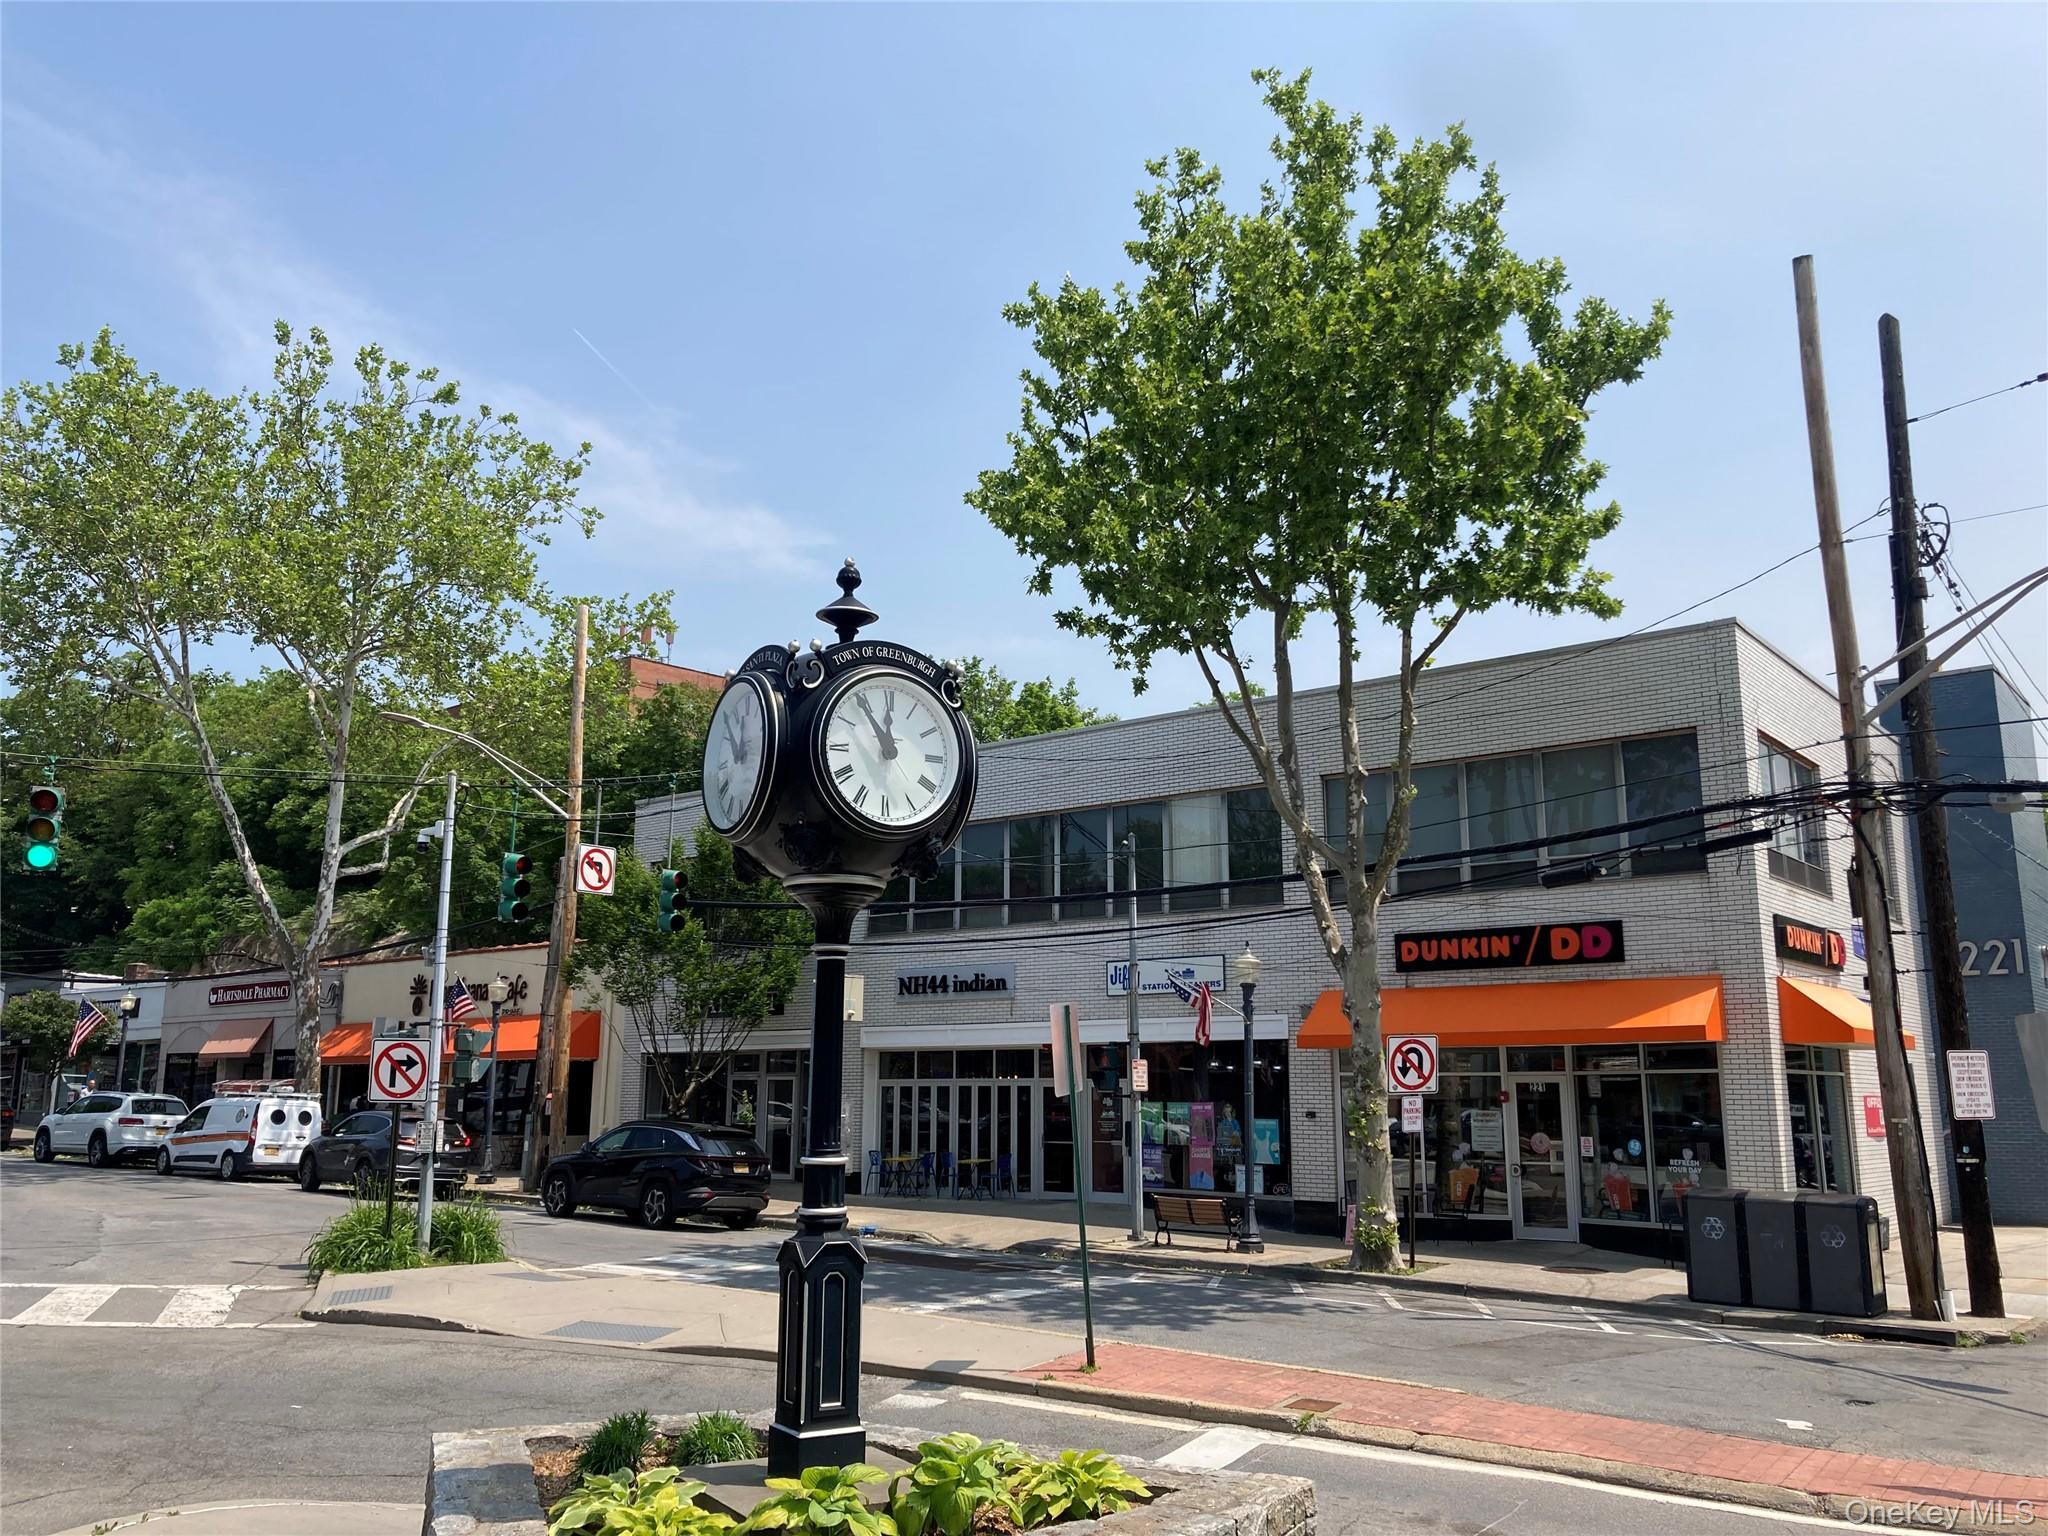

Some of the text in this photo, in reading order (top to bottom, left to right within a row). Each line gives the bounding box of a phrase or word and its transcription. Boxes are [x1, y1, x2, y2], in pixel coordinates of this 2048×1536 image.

[765, 651, 783, 666] PLAZA
[832, 646, 936, 678] TOWN OF GREENBURGH
[1401, 925, 1613, 962] DUNKIN' DD
[1786, 924, 1824, 955] DUNKIN'
[1958, 938, 2024, 977] 221
[217, 986, 290, 1003] HARTSDALE PHARMACY
[897, 973, 1008, 996] NH44 indian
[1668, 1166, 1702, 1175] YOUR DAY
[1670, 1159, 1700, 1167] REFRESH
